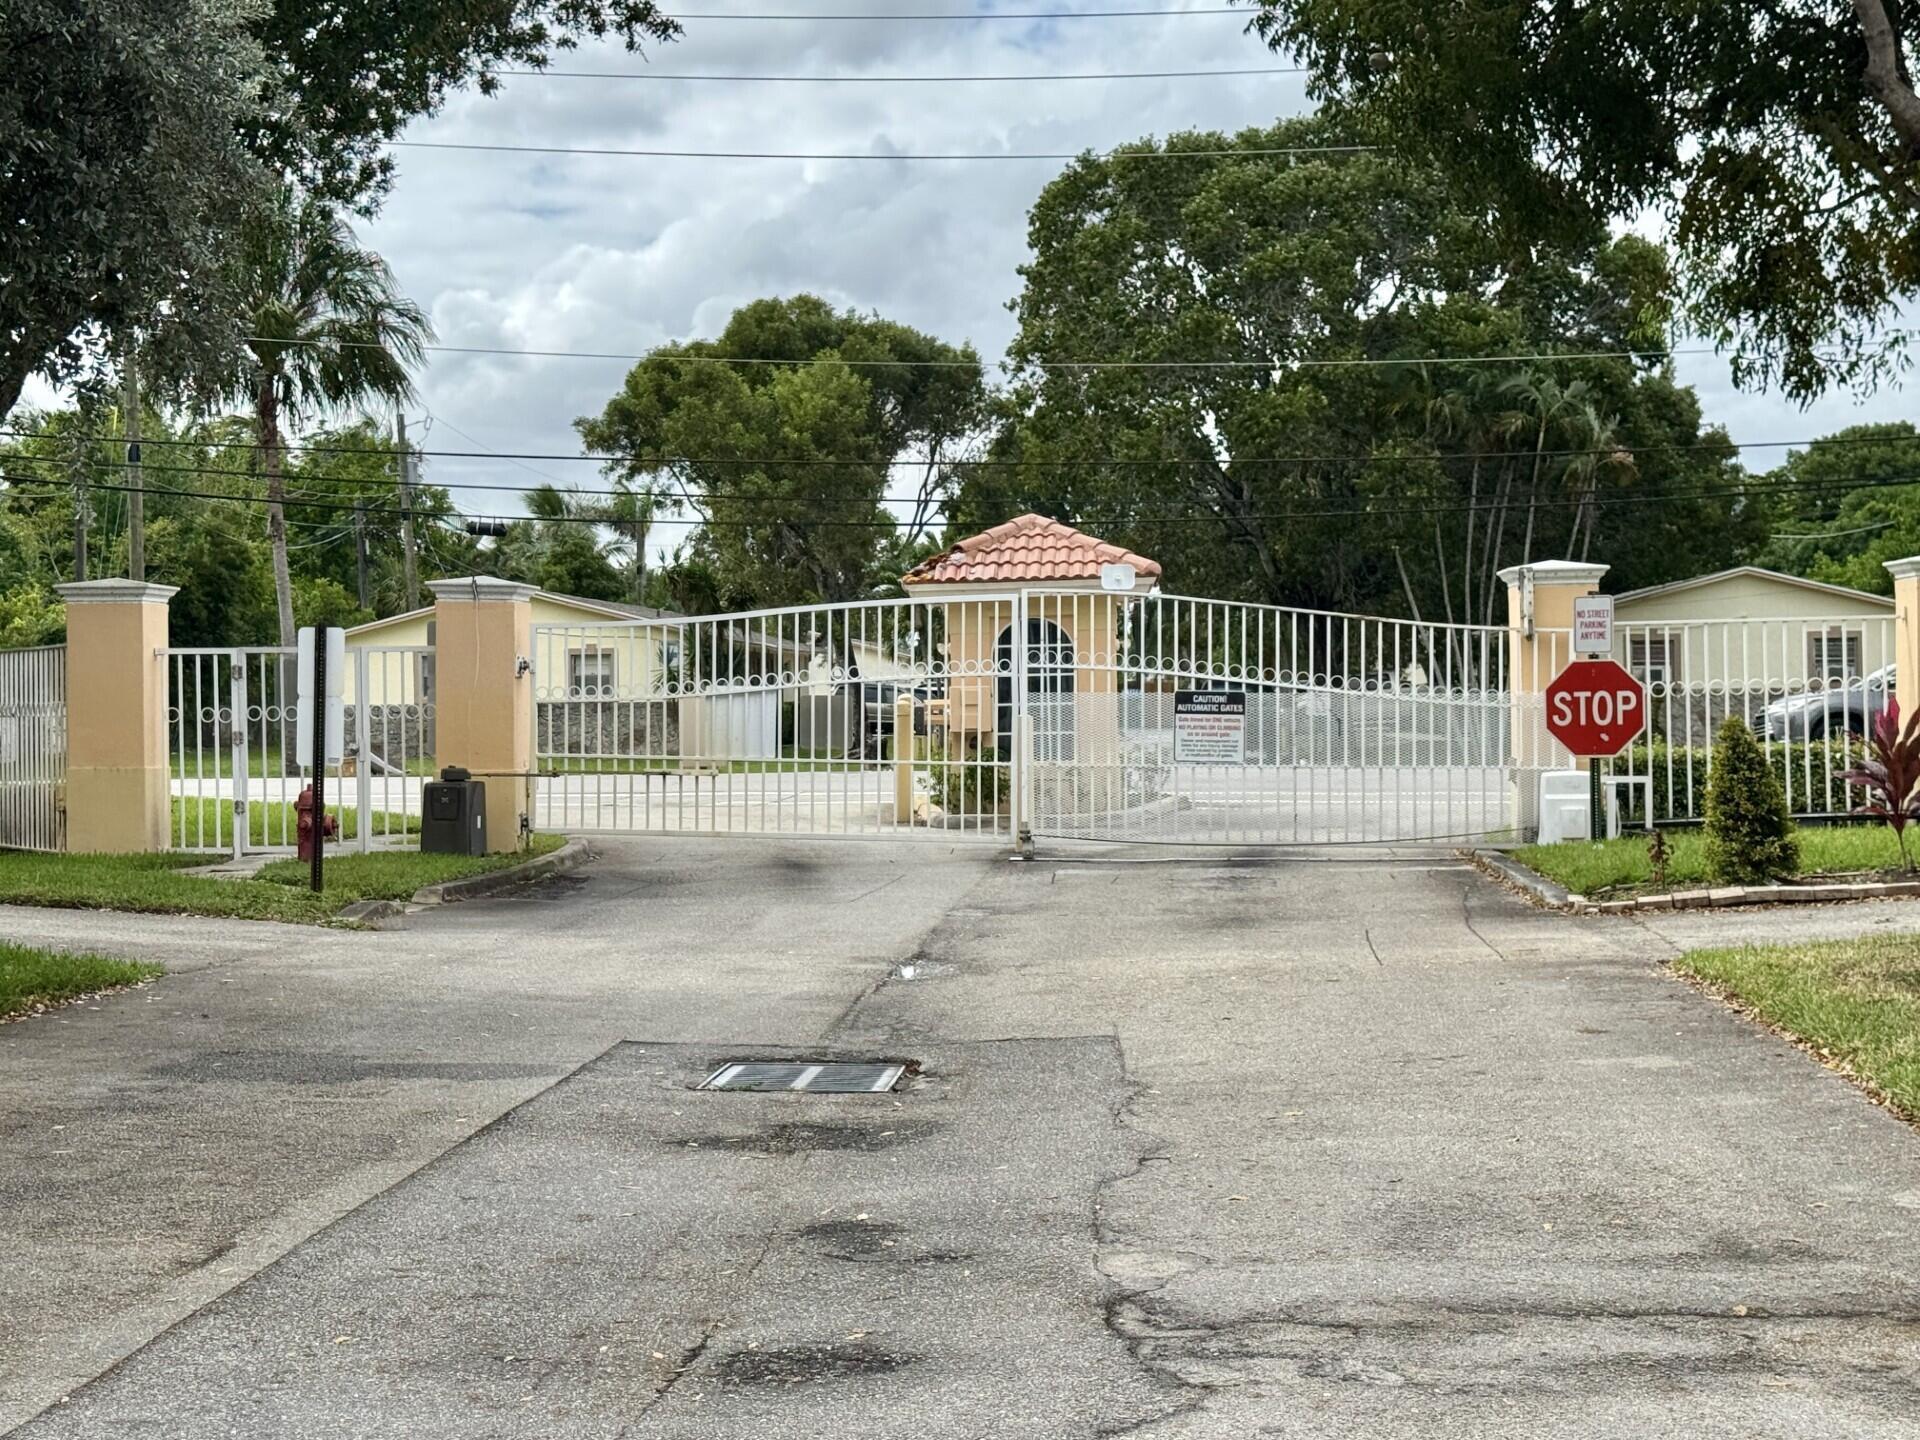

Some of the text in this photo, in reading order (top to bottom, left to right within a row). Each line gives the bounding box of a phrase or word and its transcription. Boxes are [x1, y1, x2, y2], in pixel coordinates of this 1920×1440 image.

[1577, 609, 1609, 618] NO STREET
[1580, 620, 1607, 629] PARKING
[1580, 631, 1607, 640] ANYTIME
[1192, 694, 1228, 703] CAUTION!
[1177, 703, 1244, 712] AUTOMATIC GATES
[1552, 690, 1637, 727] STOP
